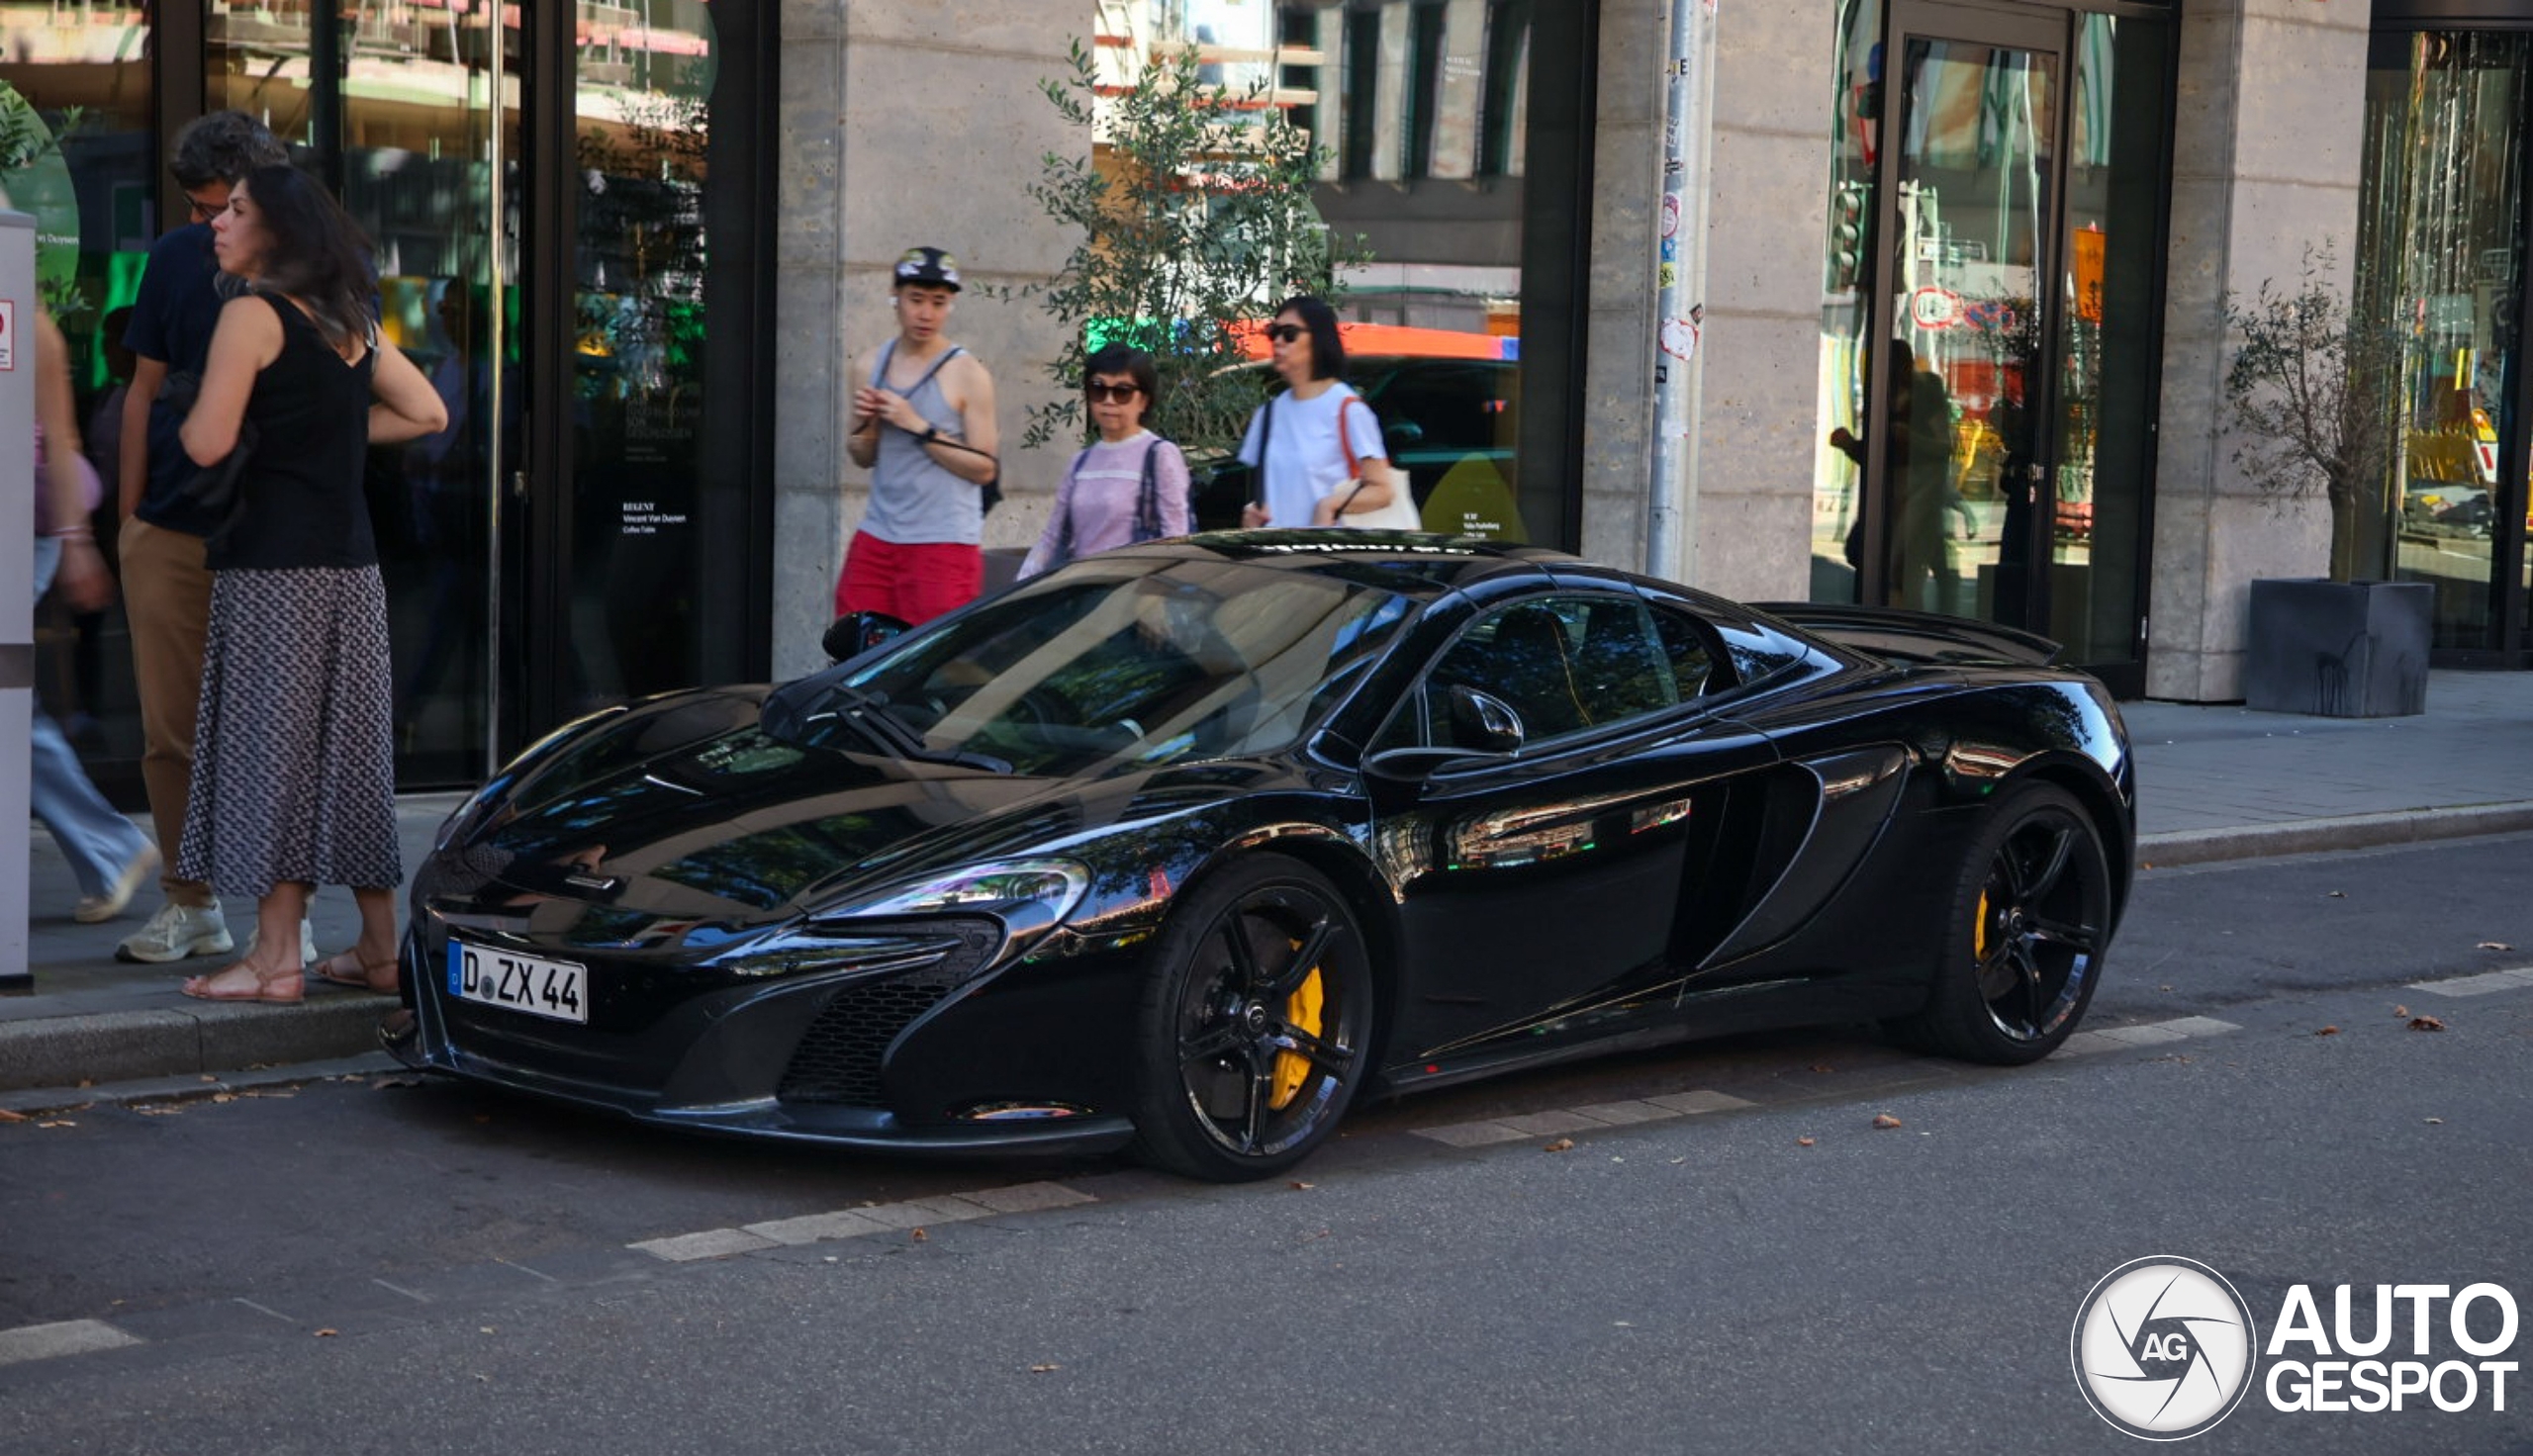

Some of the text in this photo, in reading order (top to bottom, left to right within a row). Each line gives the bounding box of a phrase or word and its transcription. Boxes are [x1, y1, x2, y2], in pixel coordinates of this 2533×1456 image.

[463, 951, 579, 1014] D ZX 44
